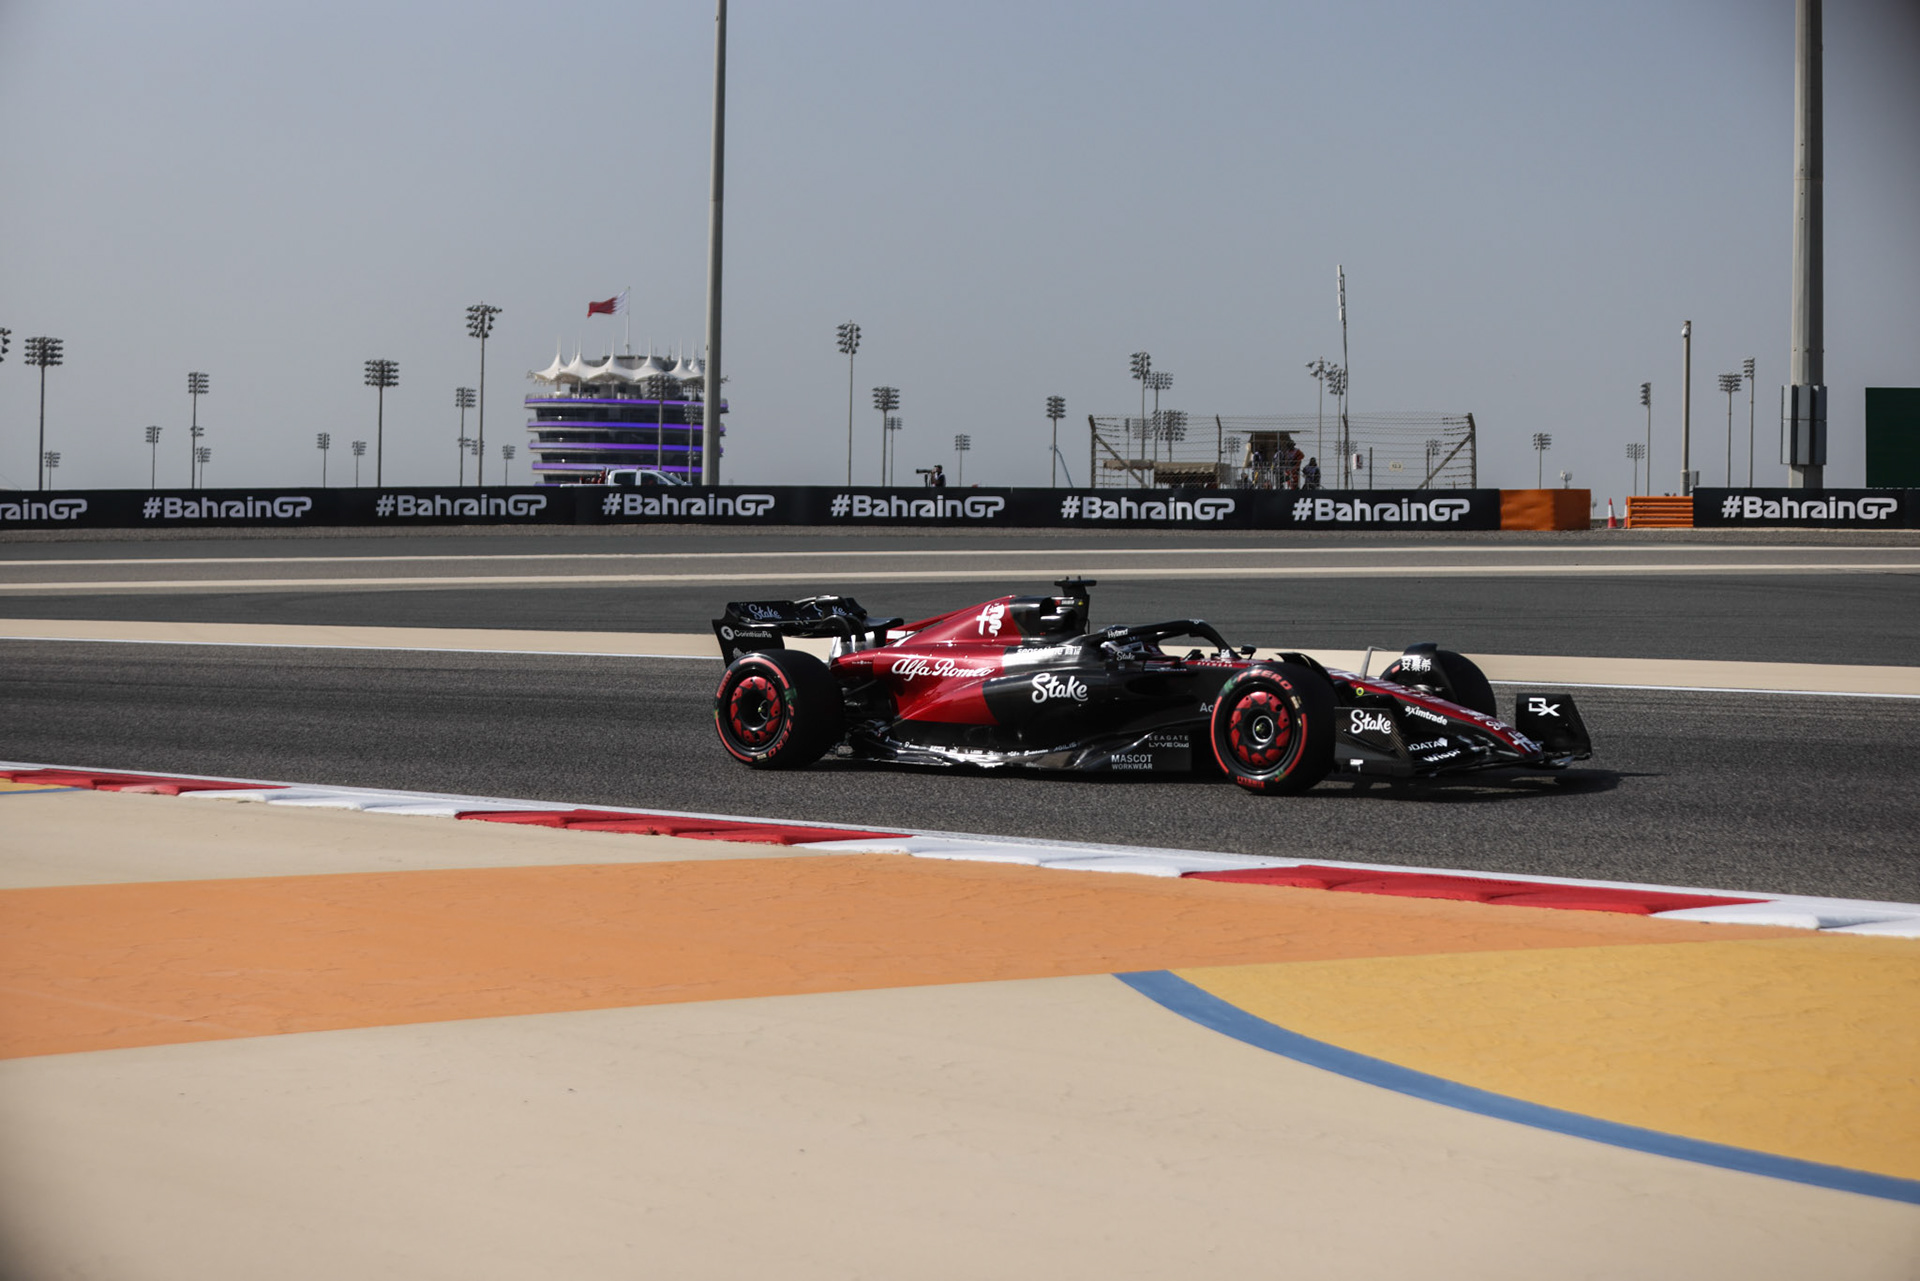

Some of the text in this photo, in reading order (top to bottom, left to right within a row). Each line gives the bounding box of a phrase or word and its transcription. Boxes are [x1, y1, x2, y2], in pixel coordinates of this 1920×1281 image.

[143, 496, 311, 518] #BahrainGP
[376, 494, 546, 516] #BahrainGP
[602, 493, 774, 516] #BahrainGP
[830, 495, 1004, 518] #BahrainGP
[1061, 496, 1235, 520] #BahrainGP
[1292, 497, 1470, 521] #BahrainGP
[1721, 496, 1898, 520] #BahrainGP
[891, 658, 995, 681] Alfa Romeo
[1031, 672, 1088, 704] Stake
[1350, 709, 1391, 734] Stake
[1111, 755, 1153, 763] MASCOT
